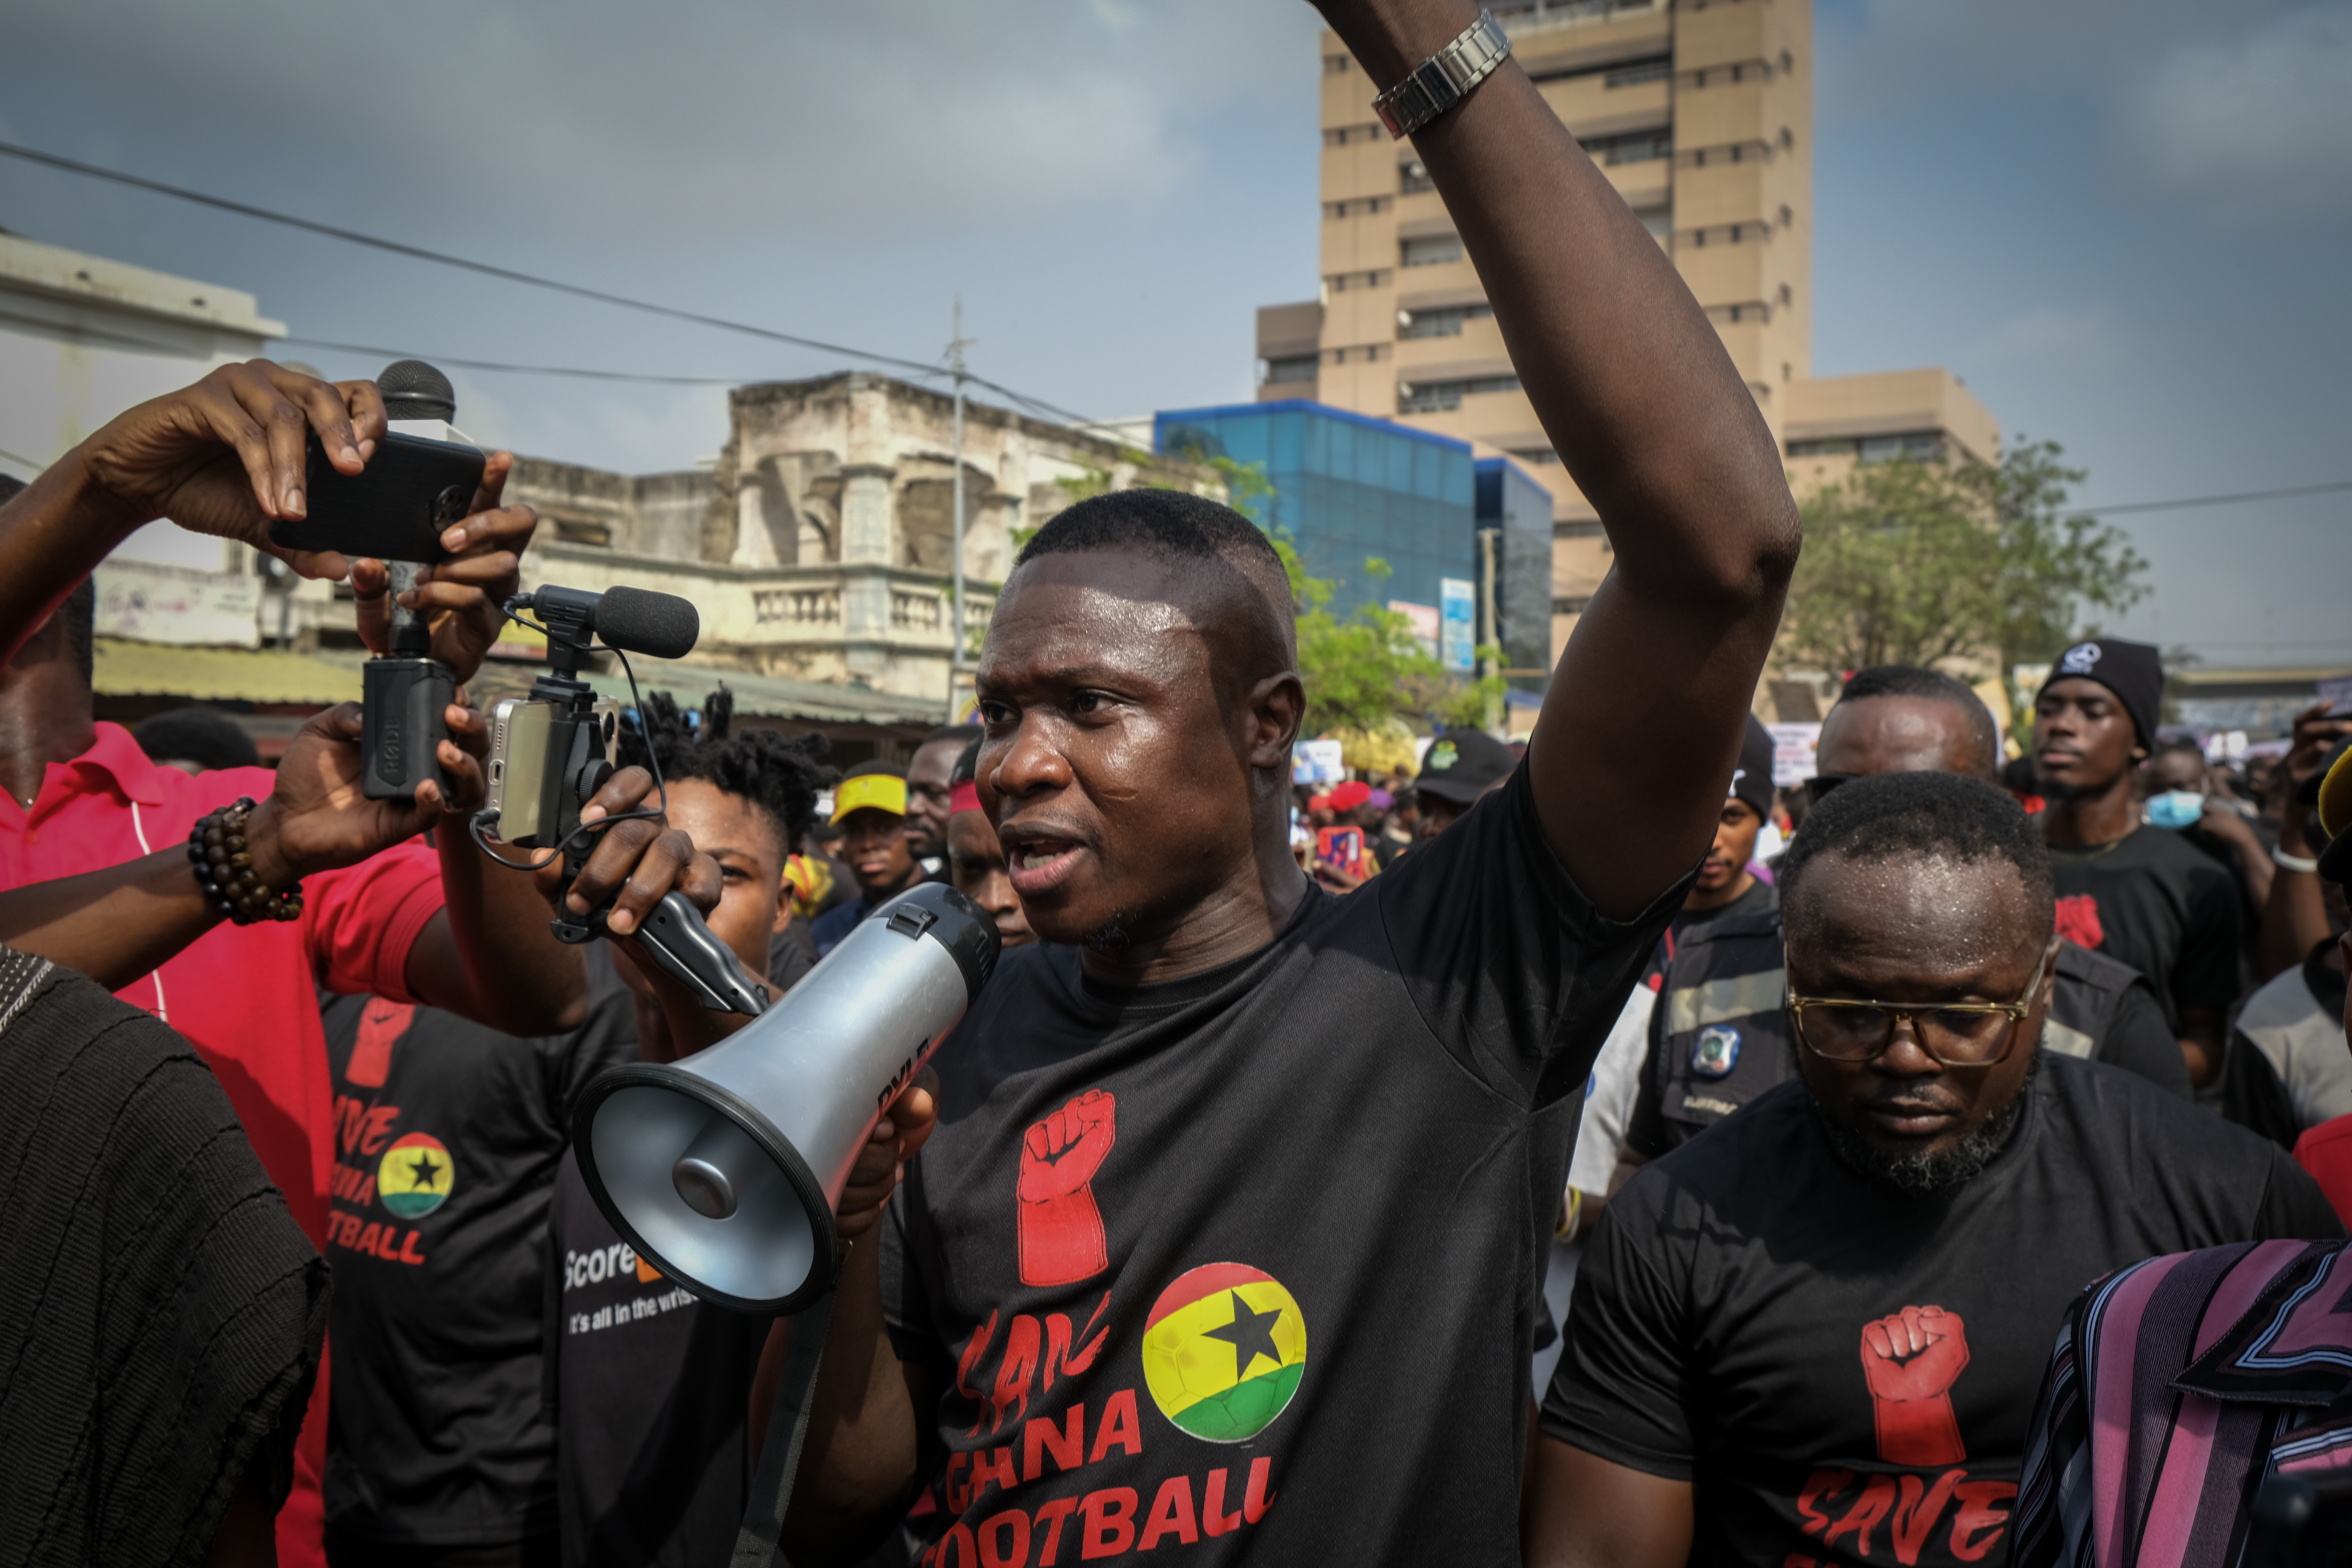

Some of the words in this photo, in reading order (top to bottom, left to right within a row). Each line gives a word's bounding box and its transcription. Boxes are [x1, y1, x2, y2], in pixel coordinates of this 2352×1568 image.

[327, 1209, 426, 1265] TBALL
[592, 1305, 612, 1331] all
[615, 1303, 631, 1326] in
[632, 1296, 658, 1320] the
[657, 1285, 700, 1313] wris
[1797, 1468, 2018, 1566] SAVE
